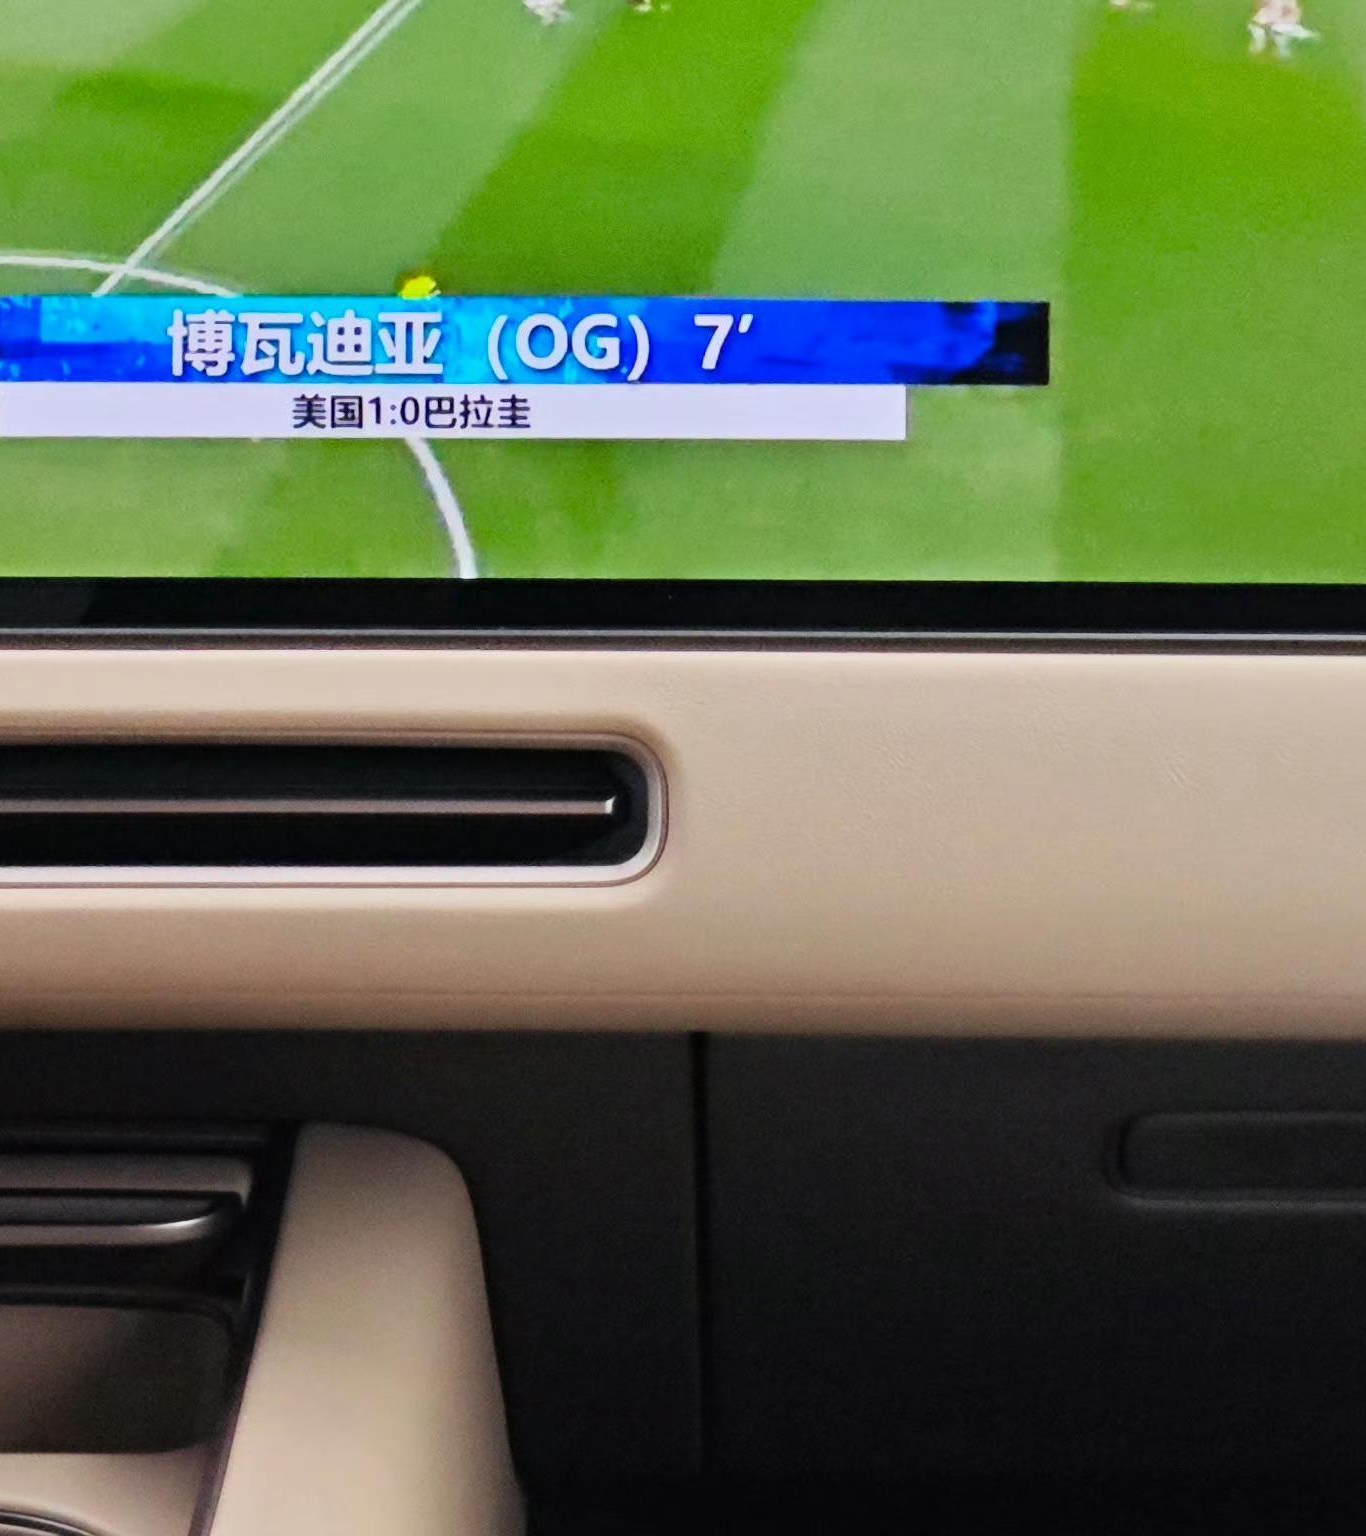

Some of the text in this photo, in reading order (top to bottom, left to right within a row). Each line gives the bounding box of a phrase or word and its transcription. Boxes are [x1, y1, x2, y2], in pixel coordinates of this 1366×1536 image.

[167, 308, 444, 378] 博瓦迪亚
[291, 393, 532, 430] 美国1:0巴拉圭
